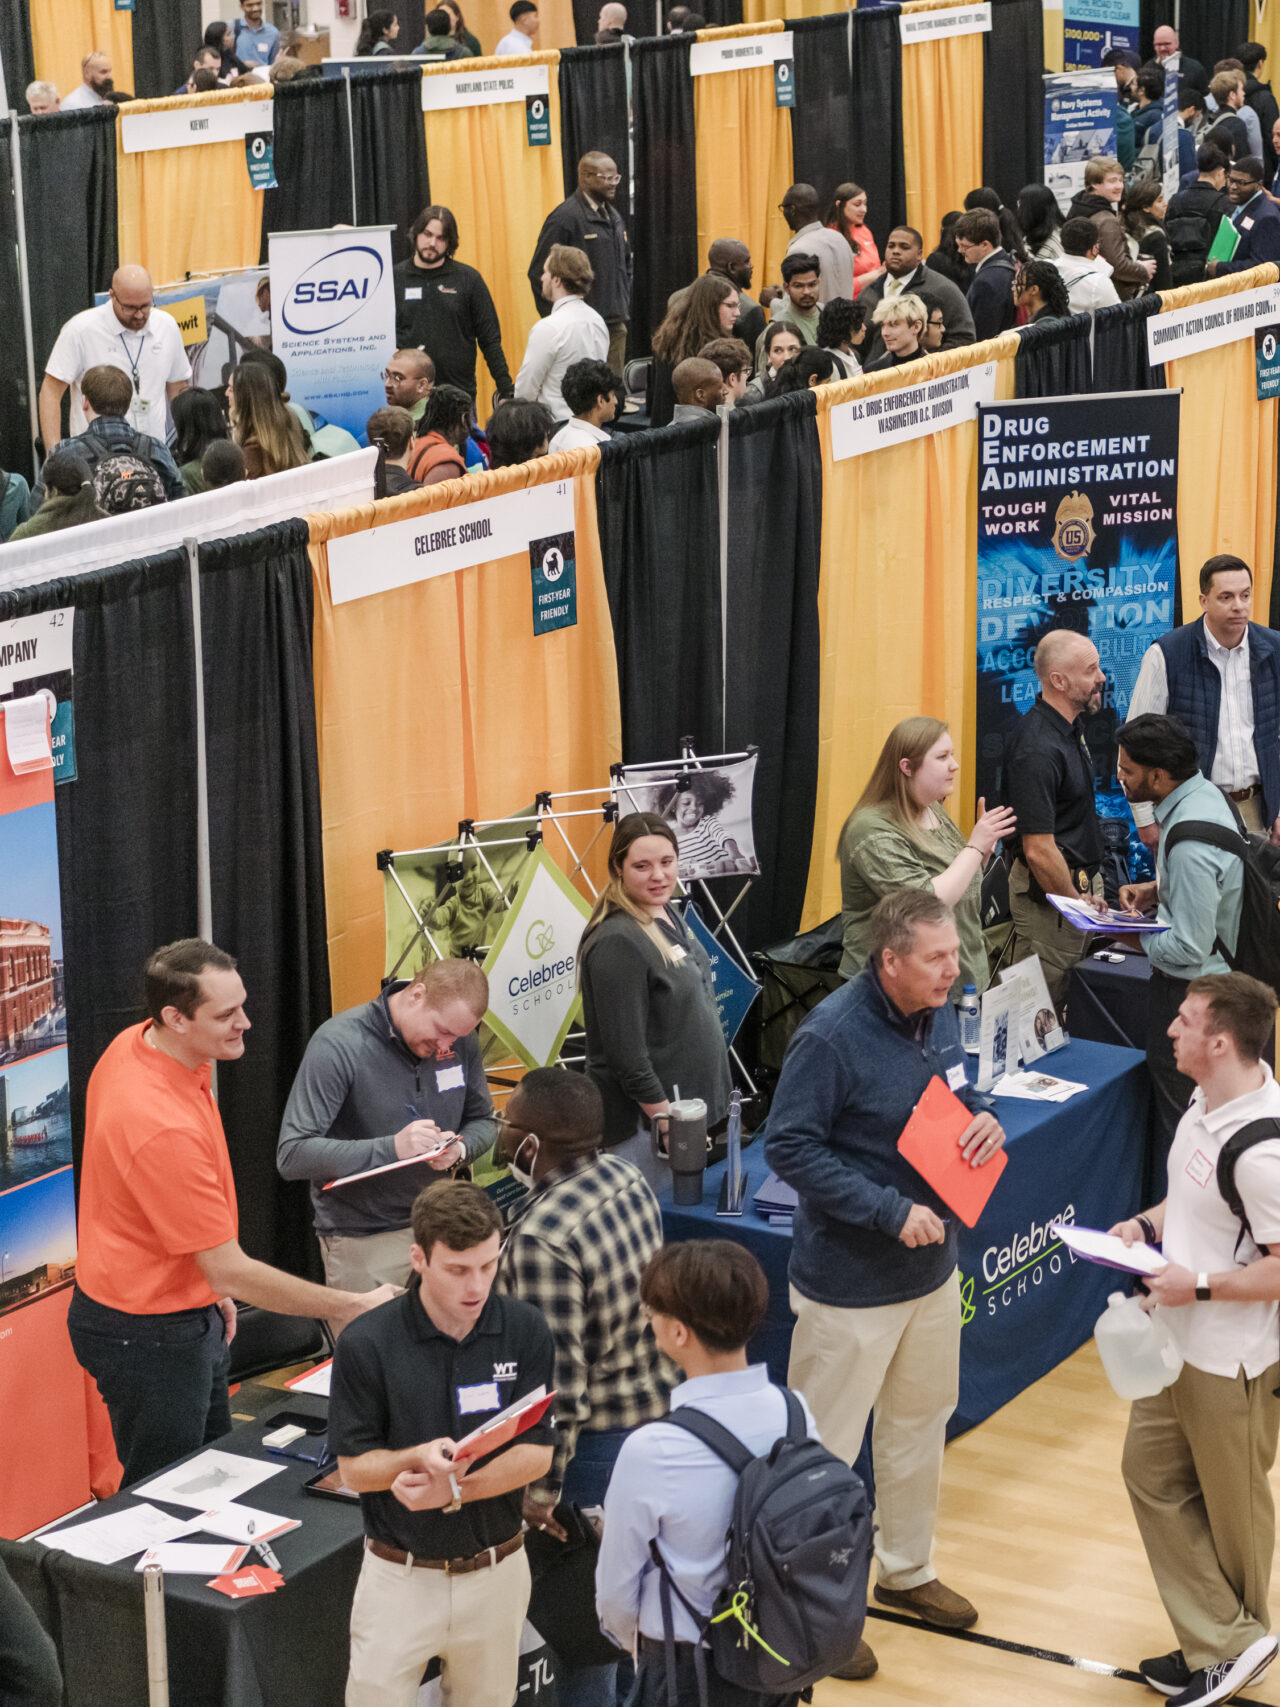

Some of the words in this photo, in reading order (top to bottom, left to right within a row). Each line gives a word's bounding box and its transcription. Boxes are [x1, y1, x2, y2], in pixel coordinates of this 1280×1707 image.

[456, 81, 482, 94] MARYLAND
[484, 80, 498, 91] STATE
[499, 78, 514, 90] POLICE
[1051, 110, 1086, 122] Management
[1087, 108, 1111, 118] Activity
[1061, 101, 1075, 110] Navy
[1076, 98, 1102, 109] Systems
[190, 118, 209, 131] KIEWIT
[294, 278, 369, 304] SSAI
[1153, 323, 1185, 346] COMMUNITY
[1185, 318, 1204, 336] ACTION
[1205, 312, 1225, 331] COUNCIL
[1226, 310, 1233, 325] OF
[1233, 303, 1255, 321] HOWARD
[1259, 365, 1280, 378] FIRST-YEAR
[1261, 379, 1279, 390] FRIENDLY
[852, 404, 865, 421] U.S.
[866, 399, 882, 417] DRUG
[883, 388, 926, 413] ENFORCEMENT
[927, 374, 970, 400] ADMINISTRATION,
[878, 410, 918, 434] WASHINGTON
[919, 406, 931, 423] D.C.
[932, 398, 953, 419] DIVISION
[983, 414, 1050, 438] DRUG
[982, 435, 1151, 465] ENFORCEMENT
[981, 458, 1175, 491] ADMINISTRATION
[556, 482, 567, 496] 41
[982, 501, 1047, 518] TOUGH
[1109, 491, 1162, 507] VITAL
[984, 519, 1040, 536] WORK
[1102, 508, 1173, 526] MISSION
[414, 527, 457, 556] CELEBREE
[459, 518, 493, 544] SCHOOL
[1065, 530, 1082, 545] US
[982, 562, 1162, 600] DIVERSITY
[538, 587, 571, 605] FIRST-YEAR
[983, 592, 1051, 609] RESPECT
[1056, 592, 1067, 603] &
[1071, 581, 1169, 601] COMPASSION
[49, 612, 65, 628] 42
[540, 604, 569, 621] FRIENDLY
[0, 638, 38, 668] MPANY
[508, 956, 574, 997] Celebree
[513, 980, 574, 1015] SCHOOL
[982, 1203, 1076, 1283] Celebree
[987, 1248, 1078, 1316] SCHOOL
[493, 1362, 517, 1374] WT
